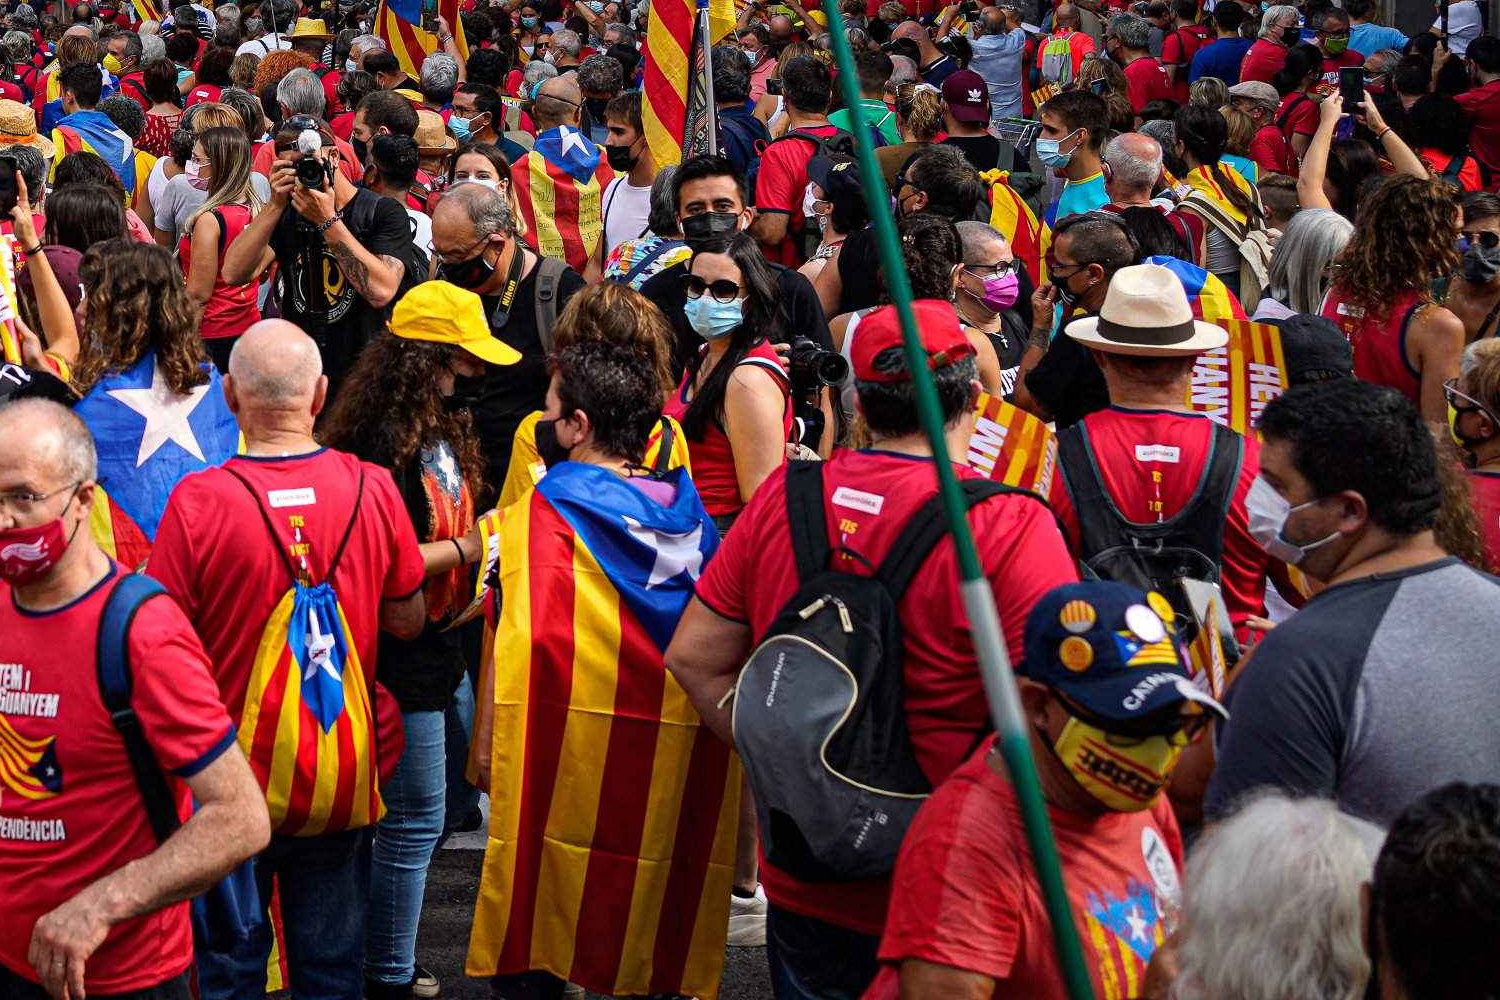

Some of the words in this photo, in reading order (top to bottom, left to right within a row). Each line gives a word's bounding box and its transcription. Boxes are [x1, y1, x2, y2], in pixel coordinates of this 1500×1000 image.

[327, 288, 355, 323] EPUBLIC
[502, 279, 516, 307] Nikon
[766, 652, 785, 707] Quechua
